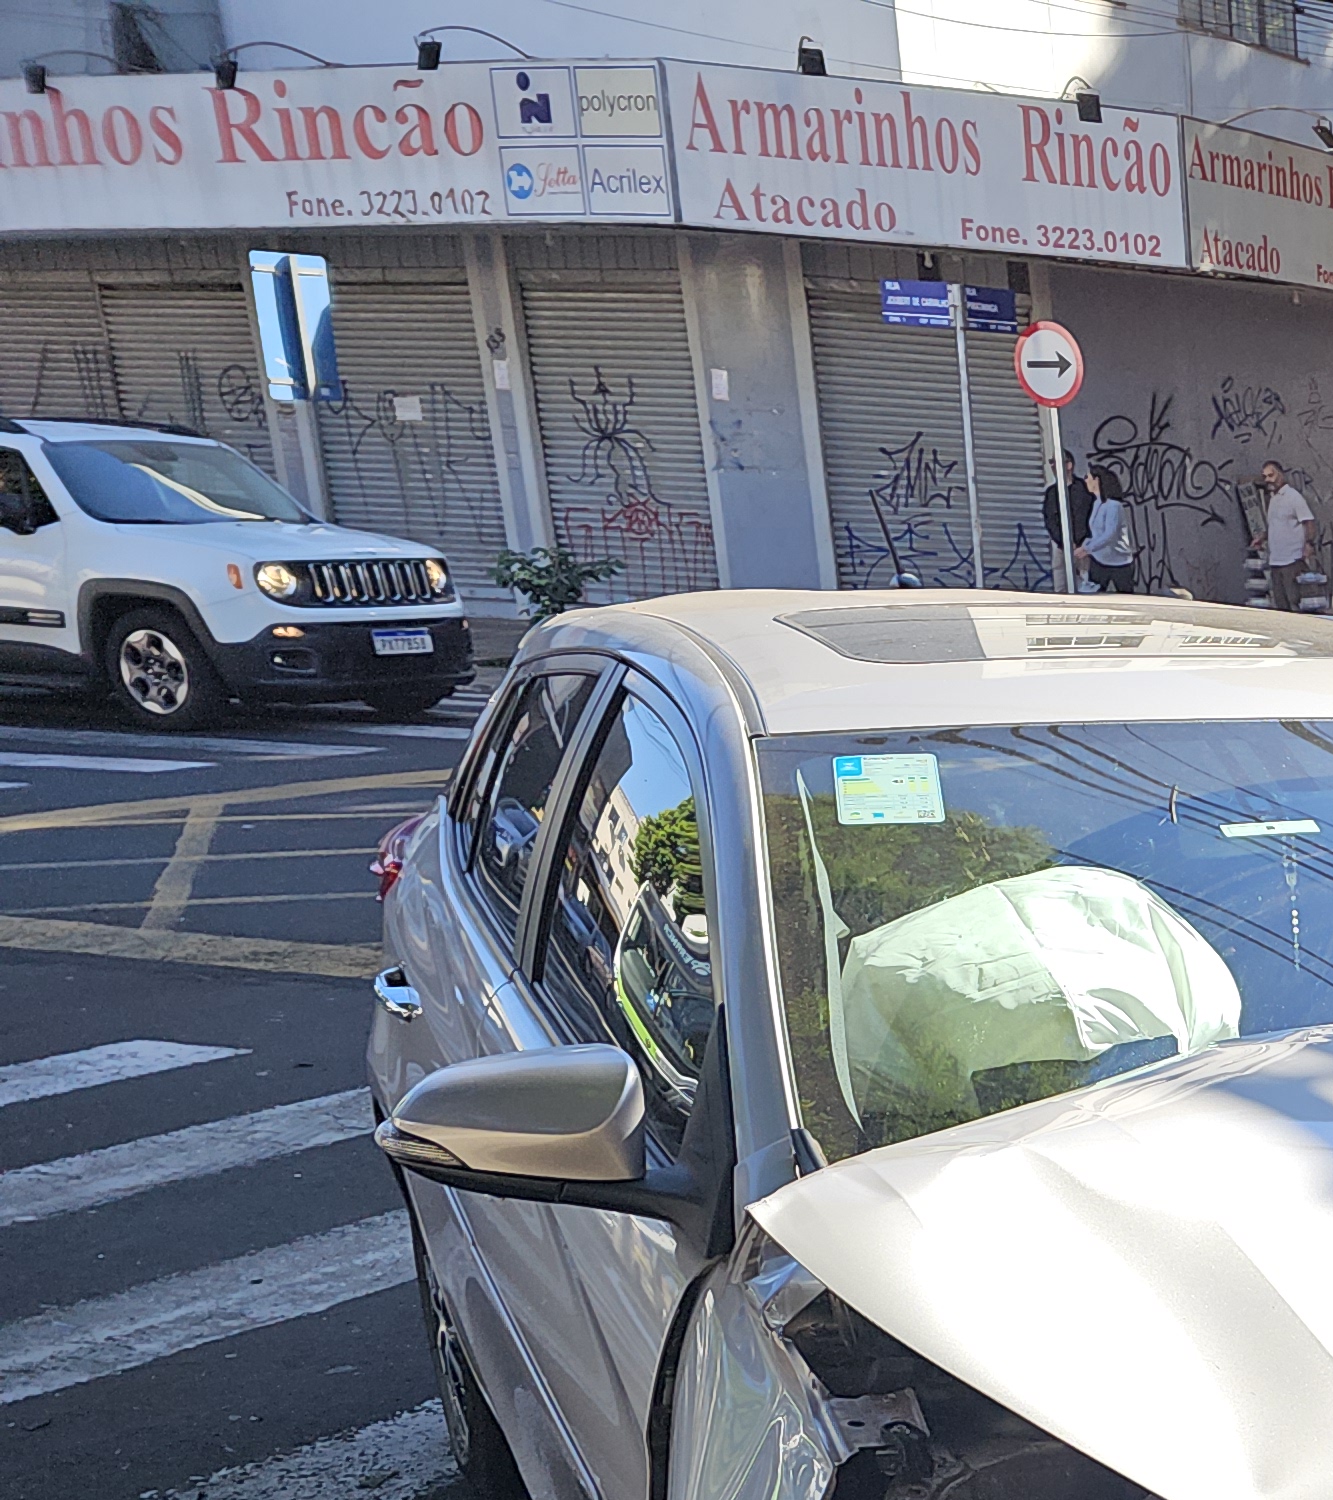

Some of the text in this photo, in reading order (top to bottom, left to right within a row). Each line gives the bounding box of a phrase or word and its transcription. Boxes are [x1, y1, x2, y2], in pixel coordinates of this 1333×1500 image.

[0, 79, 484, 168] nhos Rincão
[578, 90, 658, 117] polycron
[686, 72, 1172, 198] Armarinhos Rincão
[590, 167, 666, 194] Acrilex
[1188, 133, 1323, 207] Armarinhos
[286, 189, 353, 218] Fone.
[713, 178, 898, 233] Atacado
[961, 218, 1162, 258] Fone. 3223.0102
[1200, 225, 1281, 275] Atacado
